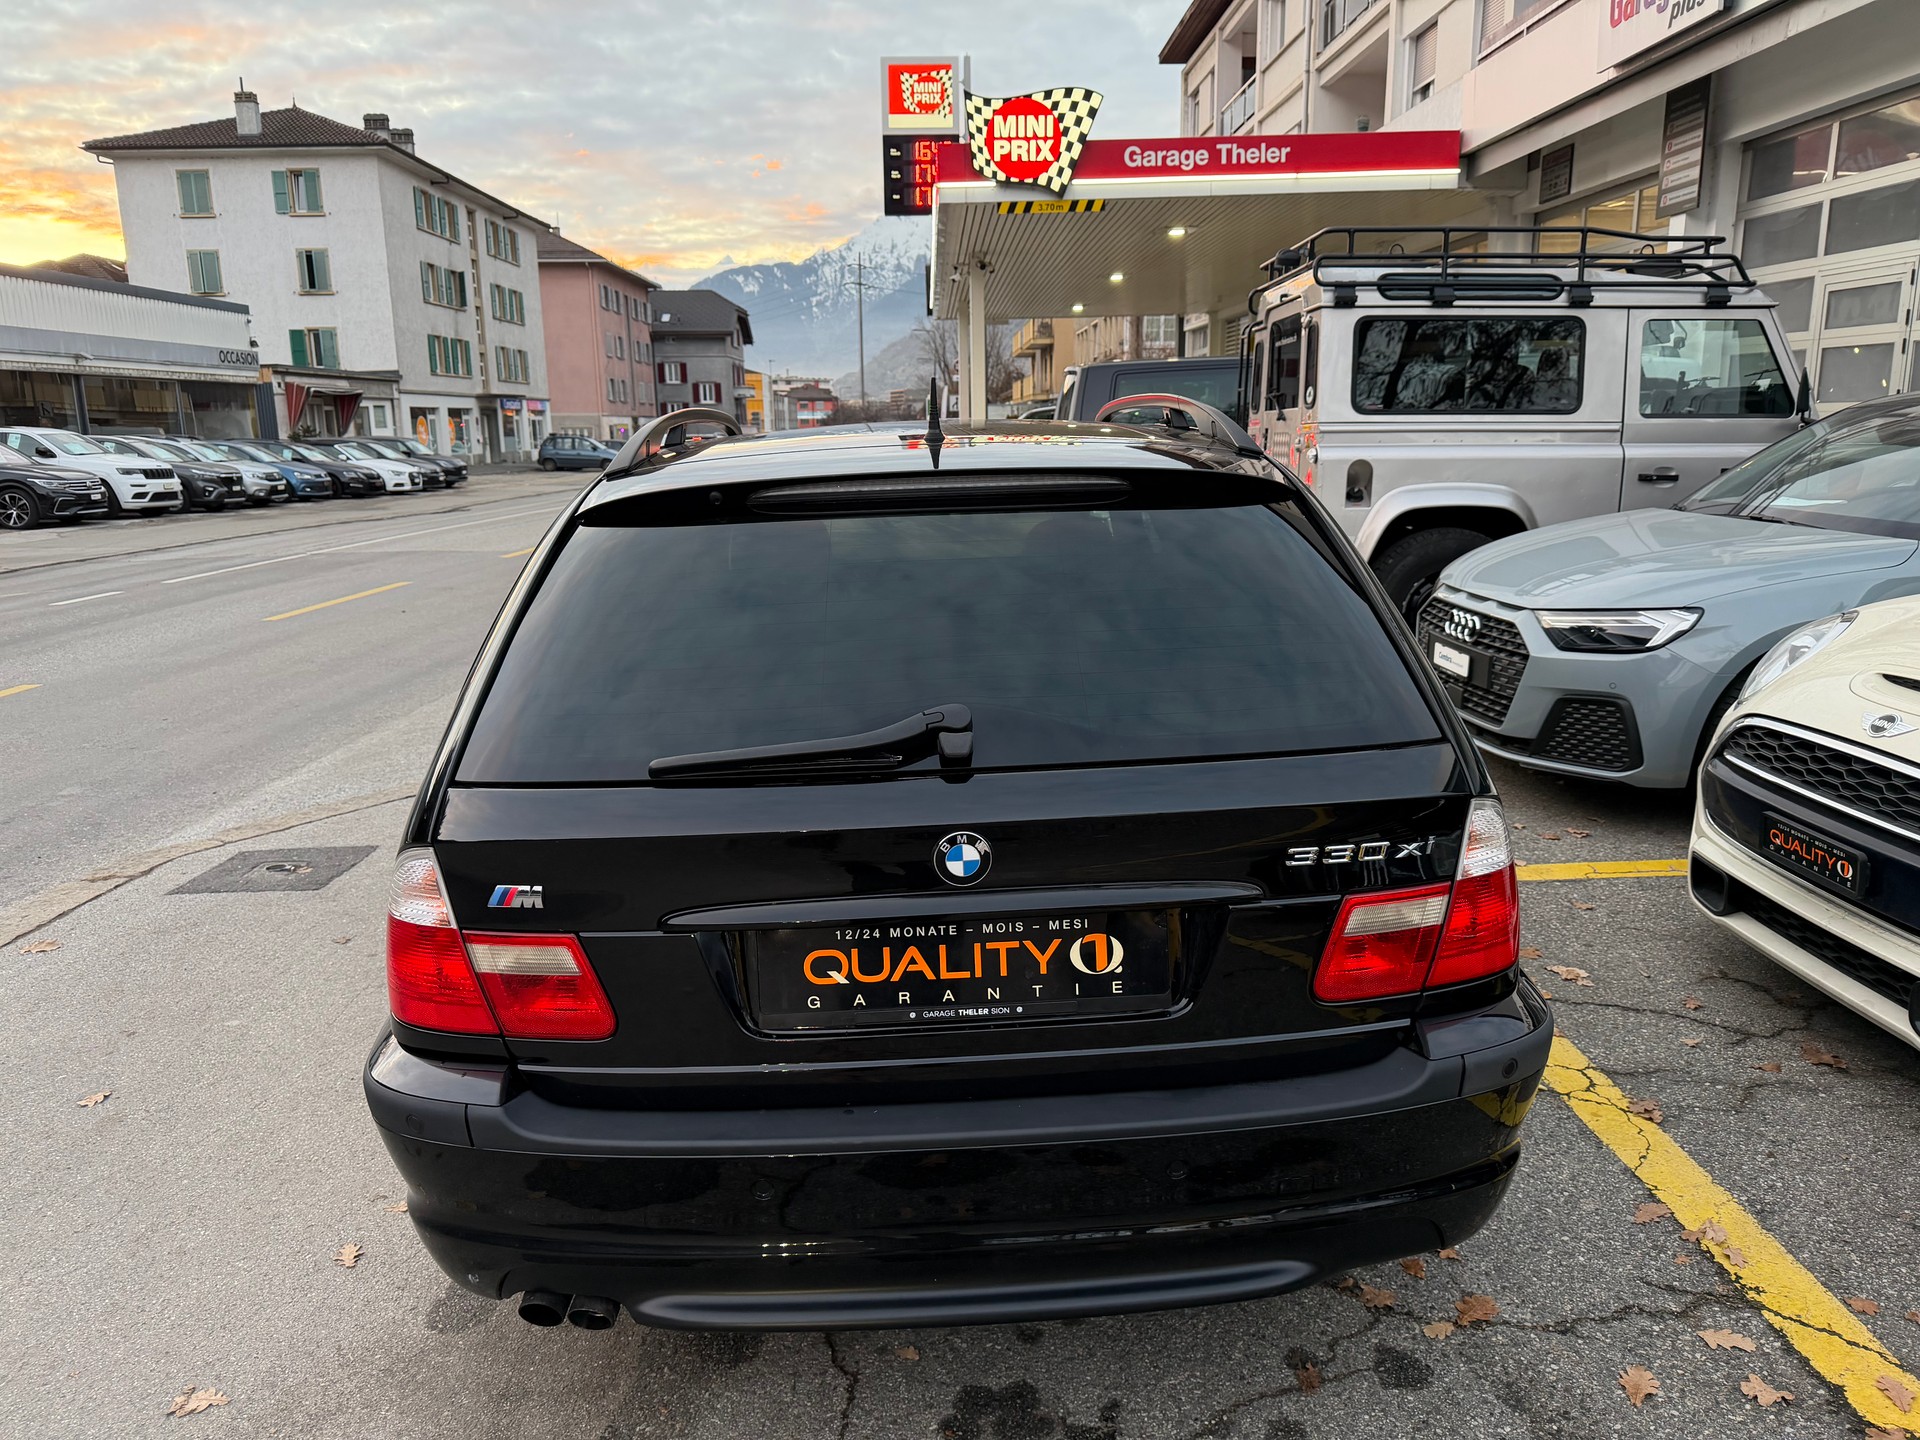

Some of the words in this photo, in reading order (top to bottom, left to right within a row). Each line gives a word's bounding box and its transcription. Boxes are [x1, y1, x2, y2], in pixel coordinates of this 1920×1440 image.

[913, 81, 942, 93] MINI
[913, 92, 943, 104] PRIX
[993, 114, 1054, 138] MINI
[993, 139, 1055, 162] PRIX
[1123, 145, 1209, 171] Garage
[1216, 143, 1291, 164] Theler
[218, 350, 259, 366] OCCASION
[939, 834, 990, 856] BMW
[1769, 829, 1837, 870] QUALITY
[1769, 844, 1852, 888] GARANTIE
[835, 928, 881, 941] 12/24
[889, 925, 958, 938] MONATE
[982, 921, 1024, 934] MOIS
[1048, 918, 1088, 931] MESI
[803, 938, 1063, 985] QUALITY
[807, 981, 1123, 1009] GARANTIE
[922, 1009, 956, 1018] GARAGE
[958, 1008, 989, 1017] THELER
[990, 1007, 1010, 1015] SION
